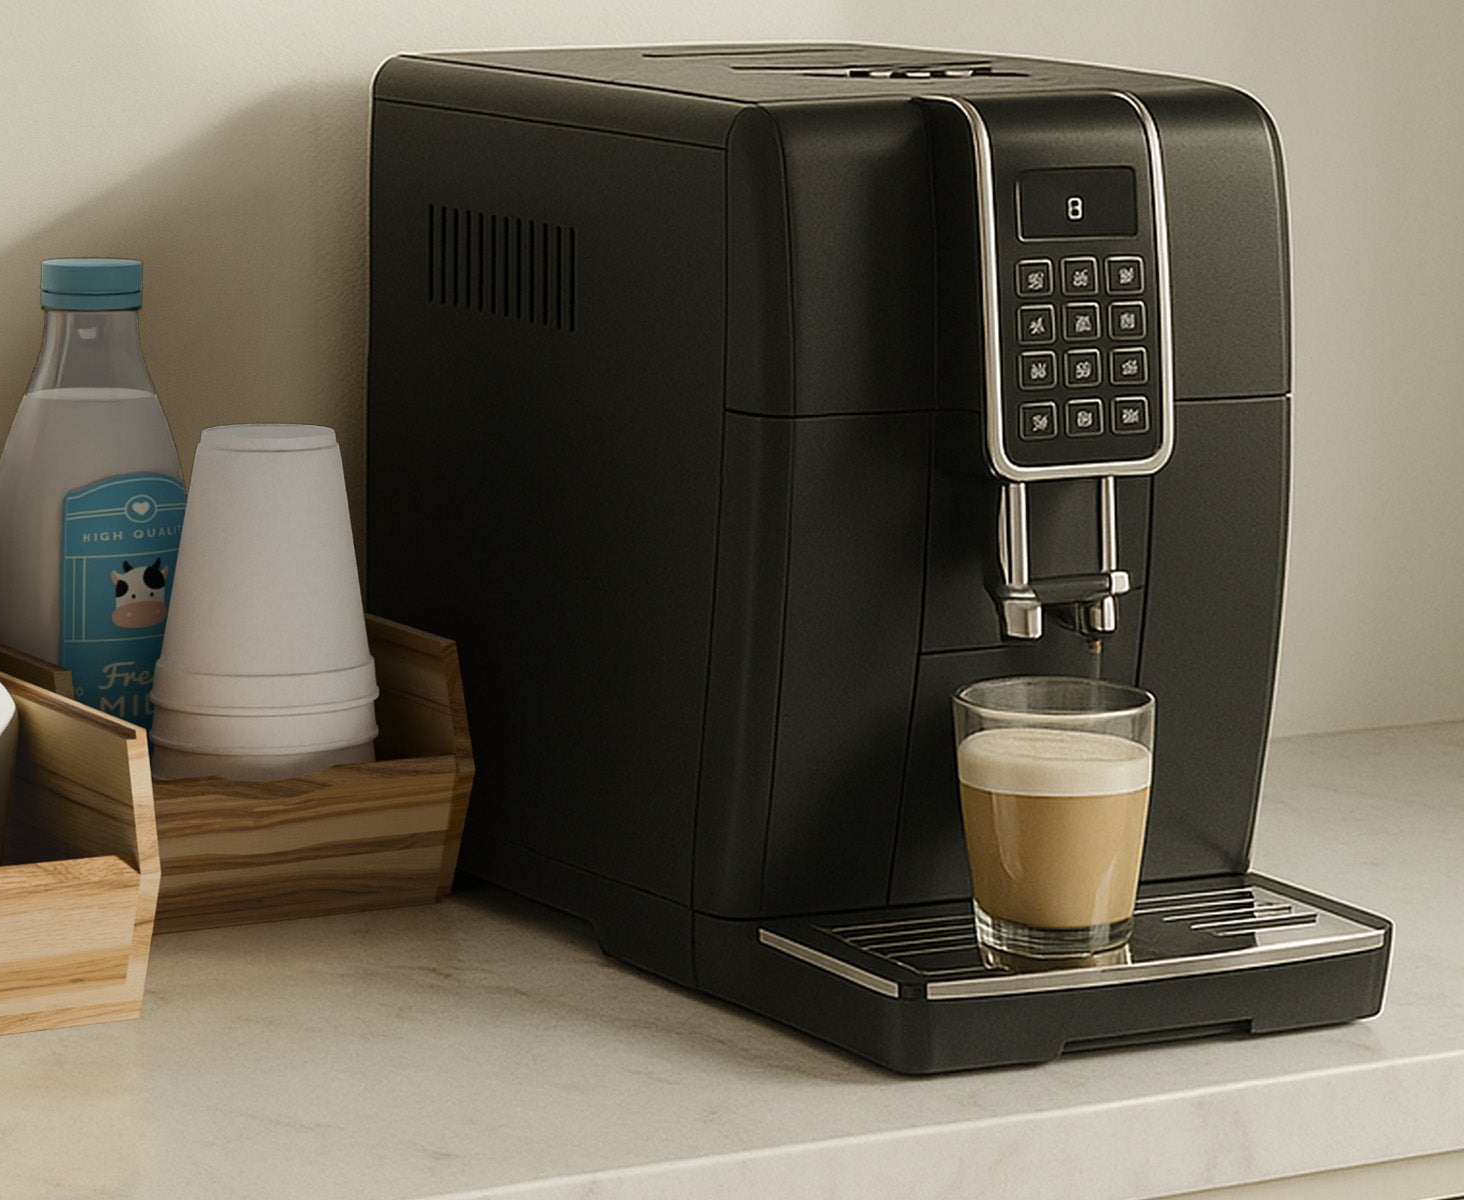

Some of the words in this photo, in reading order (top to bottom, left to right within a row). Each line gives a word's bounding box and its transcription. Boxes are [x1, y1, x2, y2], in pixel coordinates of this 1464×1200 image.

[82, 530, 124, 543] HIGH
[133, 524, 183, 539] QUALIT
[98, 660, 154, 691] Fre
[98, 693, 154, 718] MIL
